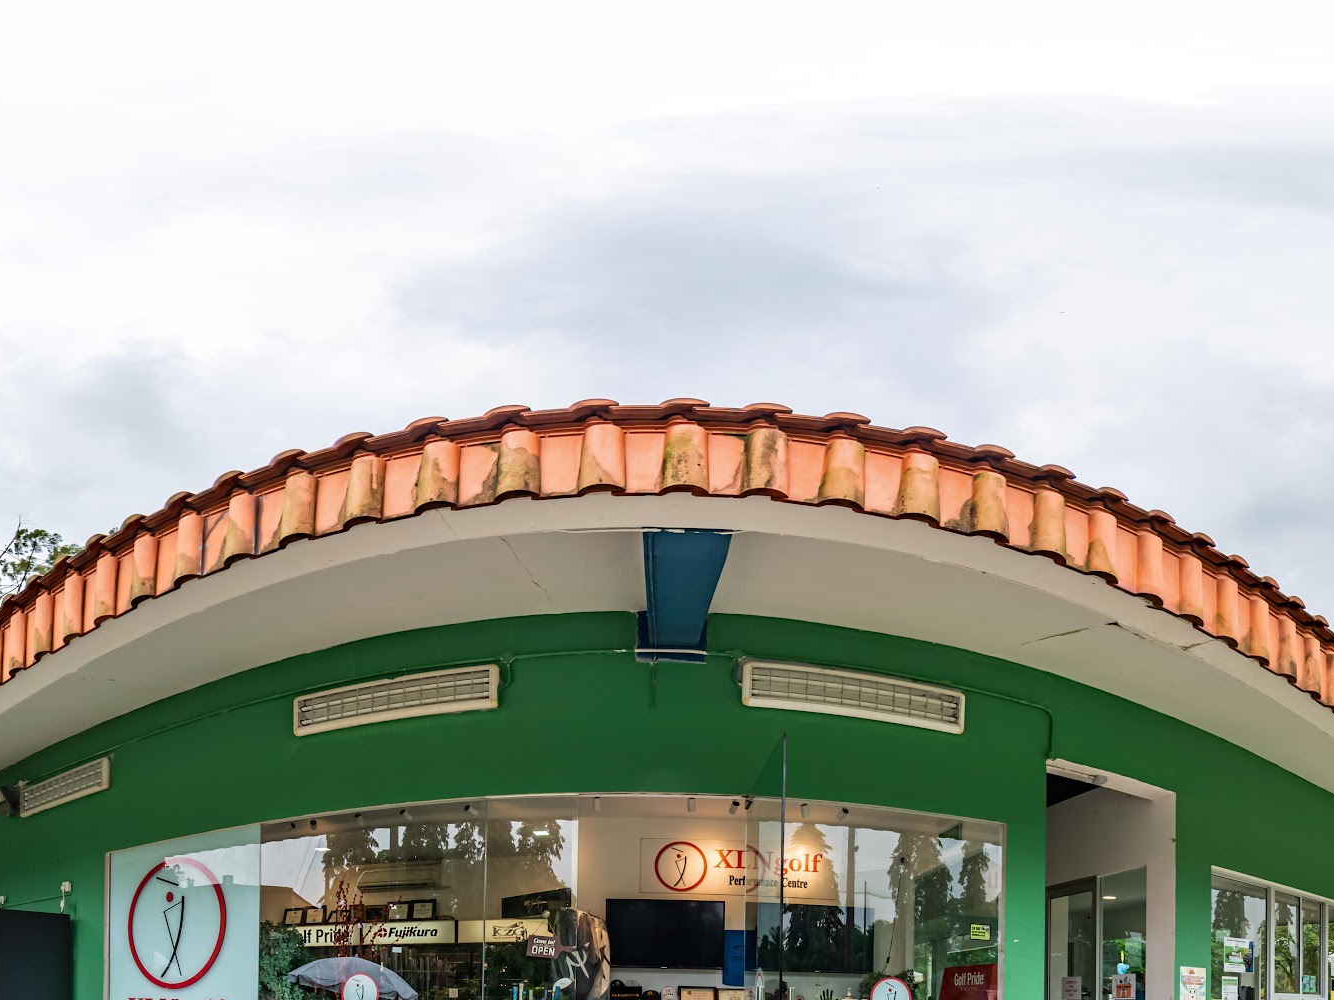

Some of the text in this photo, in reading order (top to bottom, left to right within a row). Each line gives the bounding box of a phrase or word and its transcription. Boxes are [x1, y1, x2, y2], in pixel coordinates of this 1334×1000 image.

[388, 926, 438, 939] Fujikura
[531, 946, 555, 956] OPEN
[954, 972, 984, 986] Golf Pride
